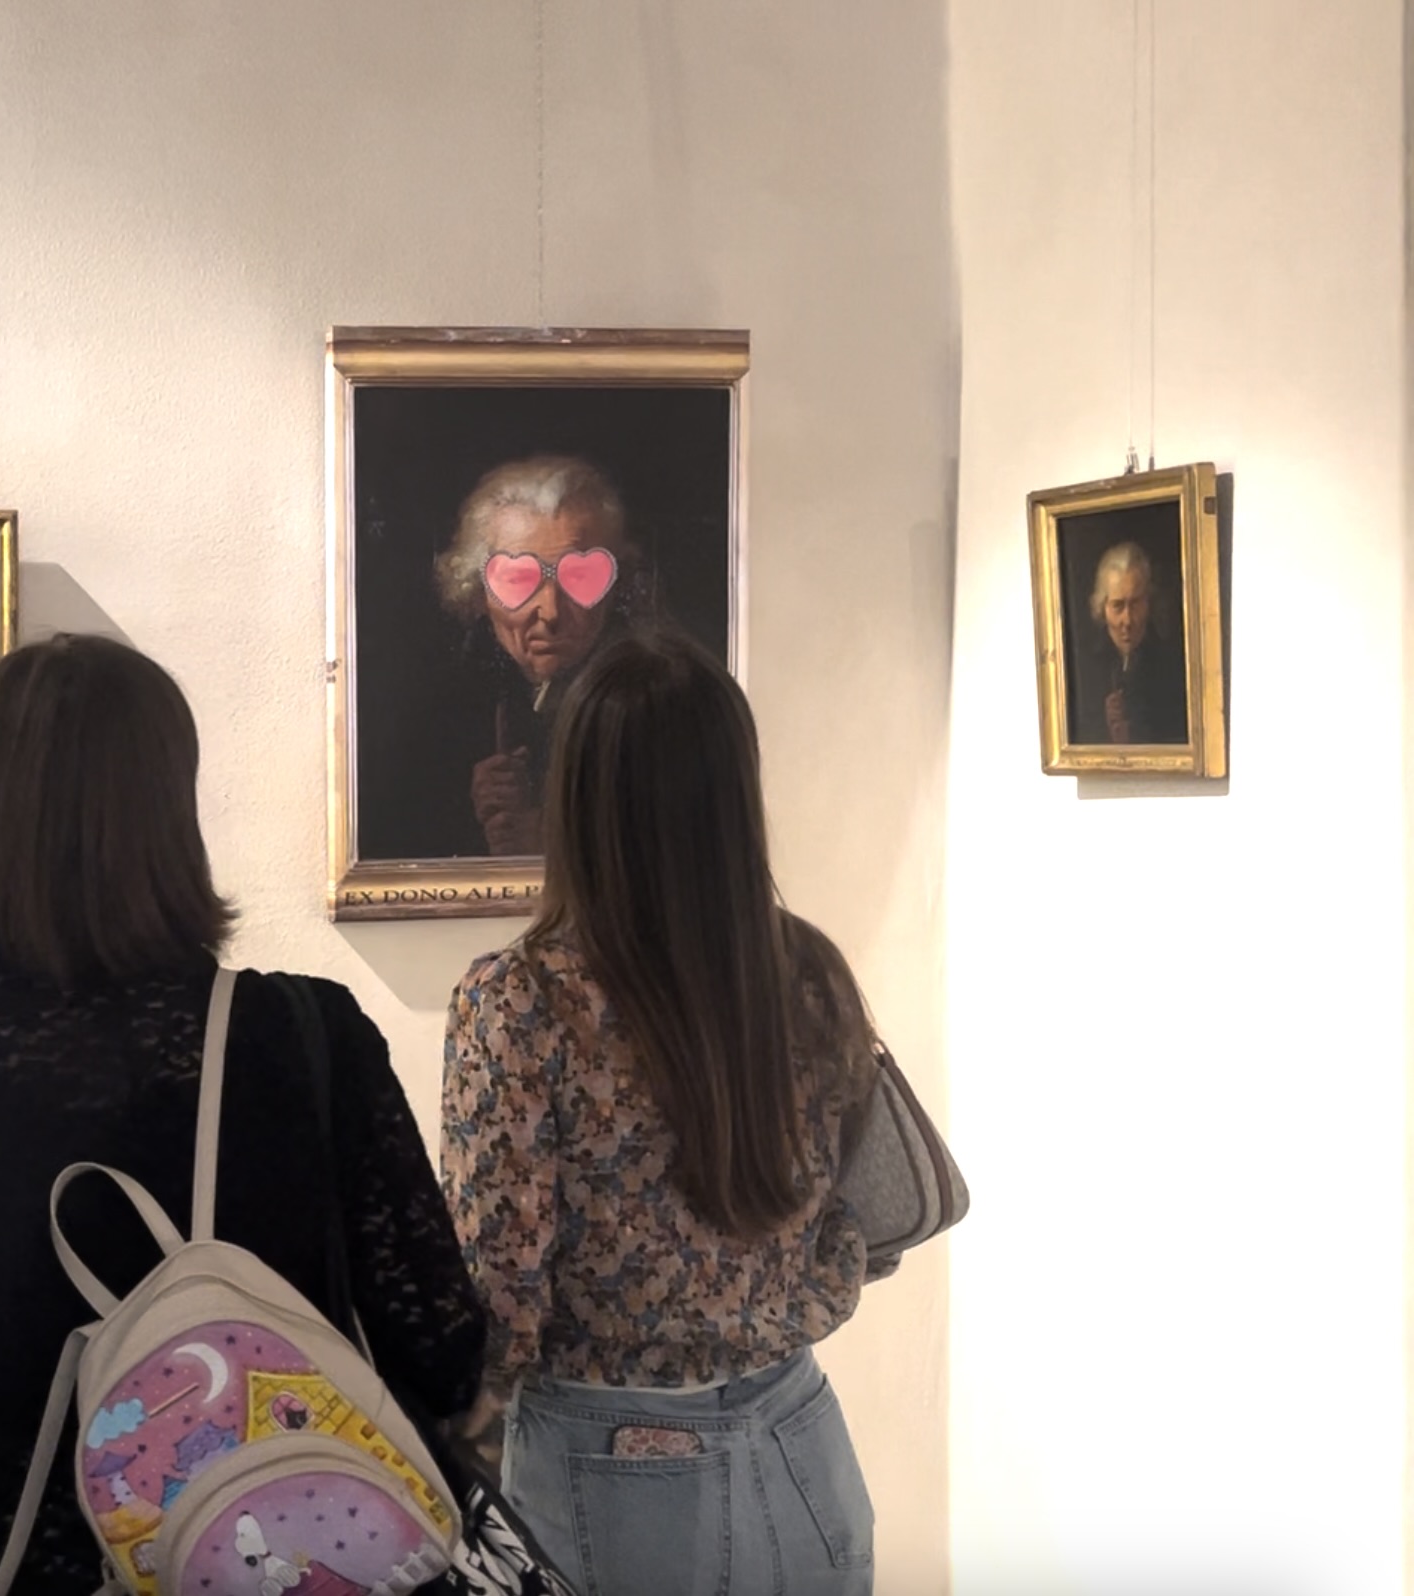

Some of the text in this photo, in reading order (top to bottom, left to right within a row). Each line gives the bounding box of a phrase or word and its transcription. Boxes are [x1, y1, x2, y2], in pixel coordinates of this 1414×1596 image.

[344, 891, 374, 906] EX
[382, 887, 458, 904] DONO
[466, 886, 515, 901] ALE
